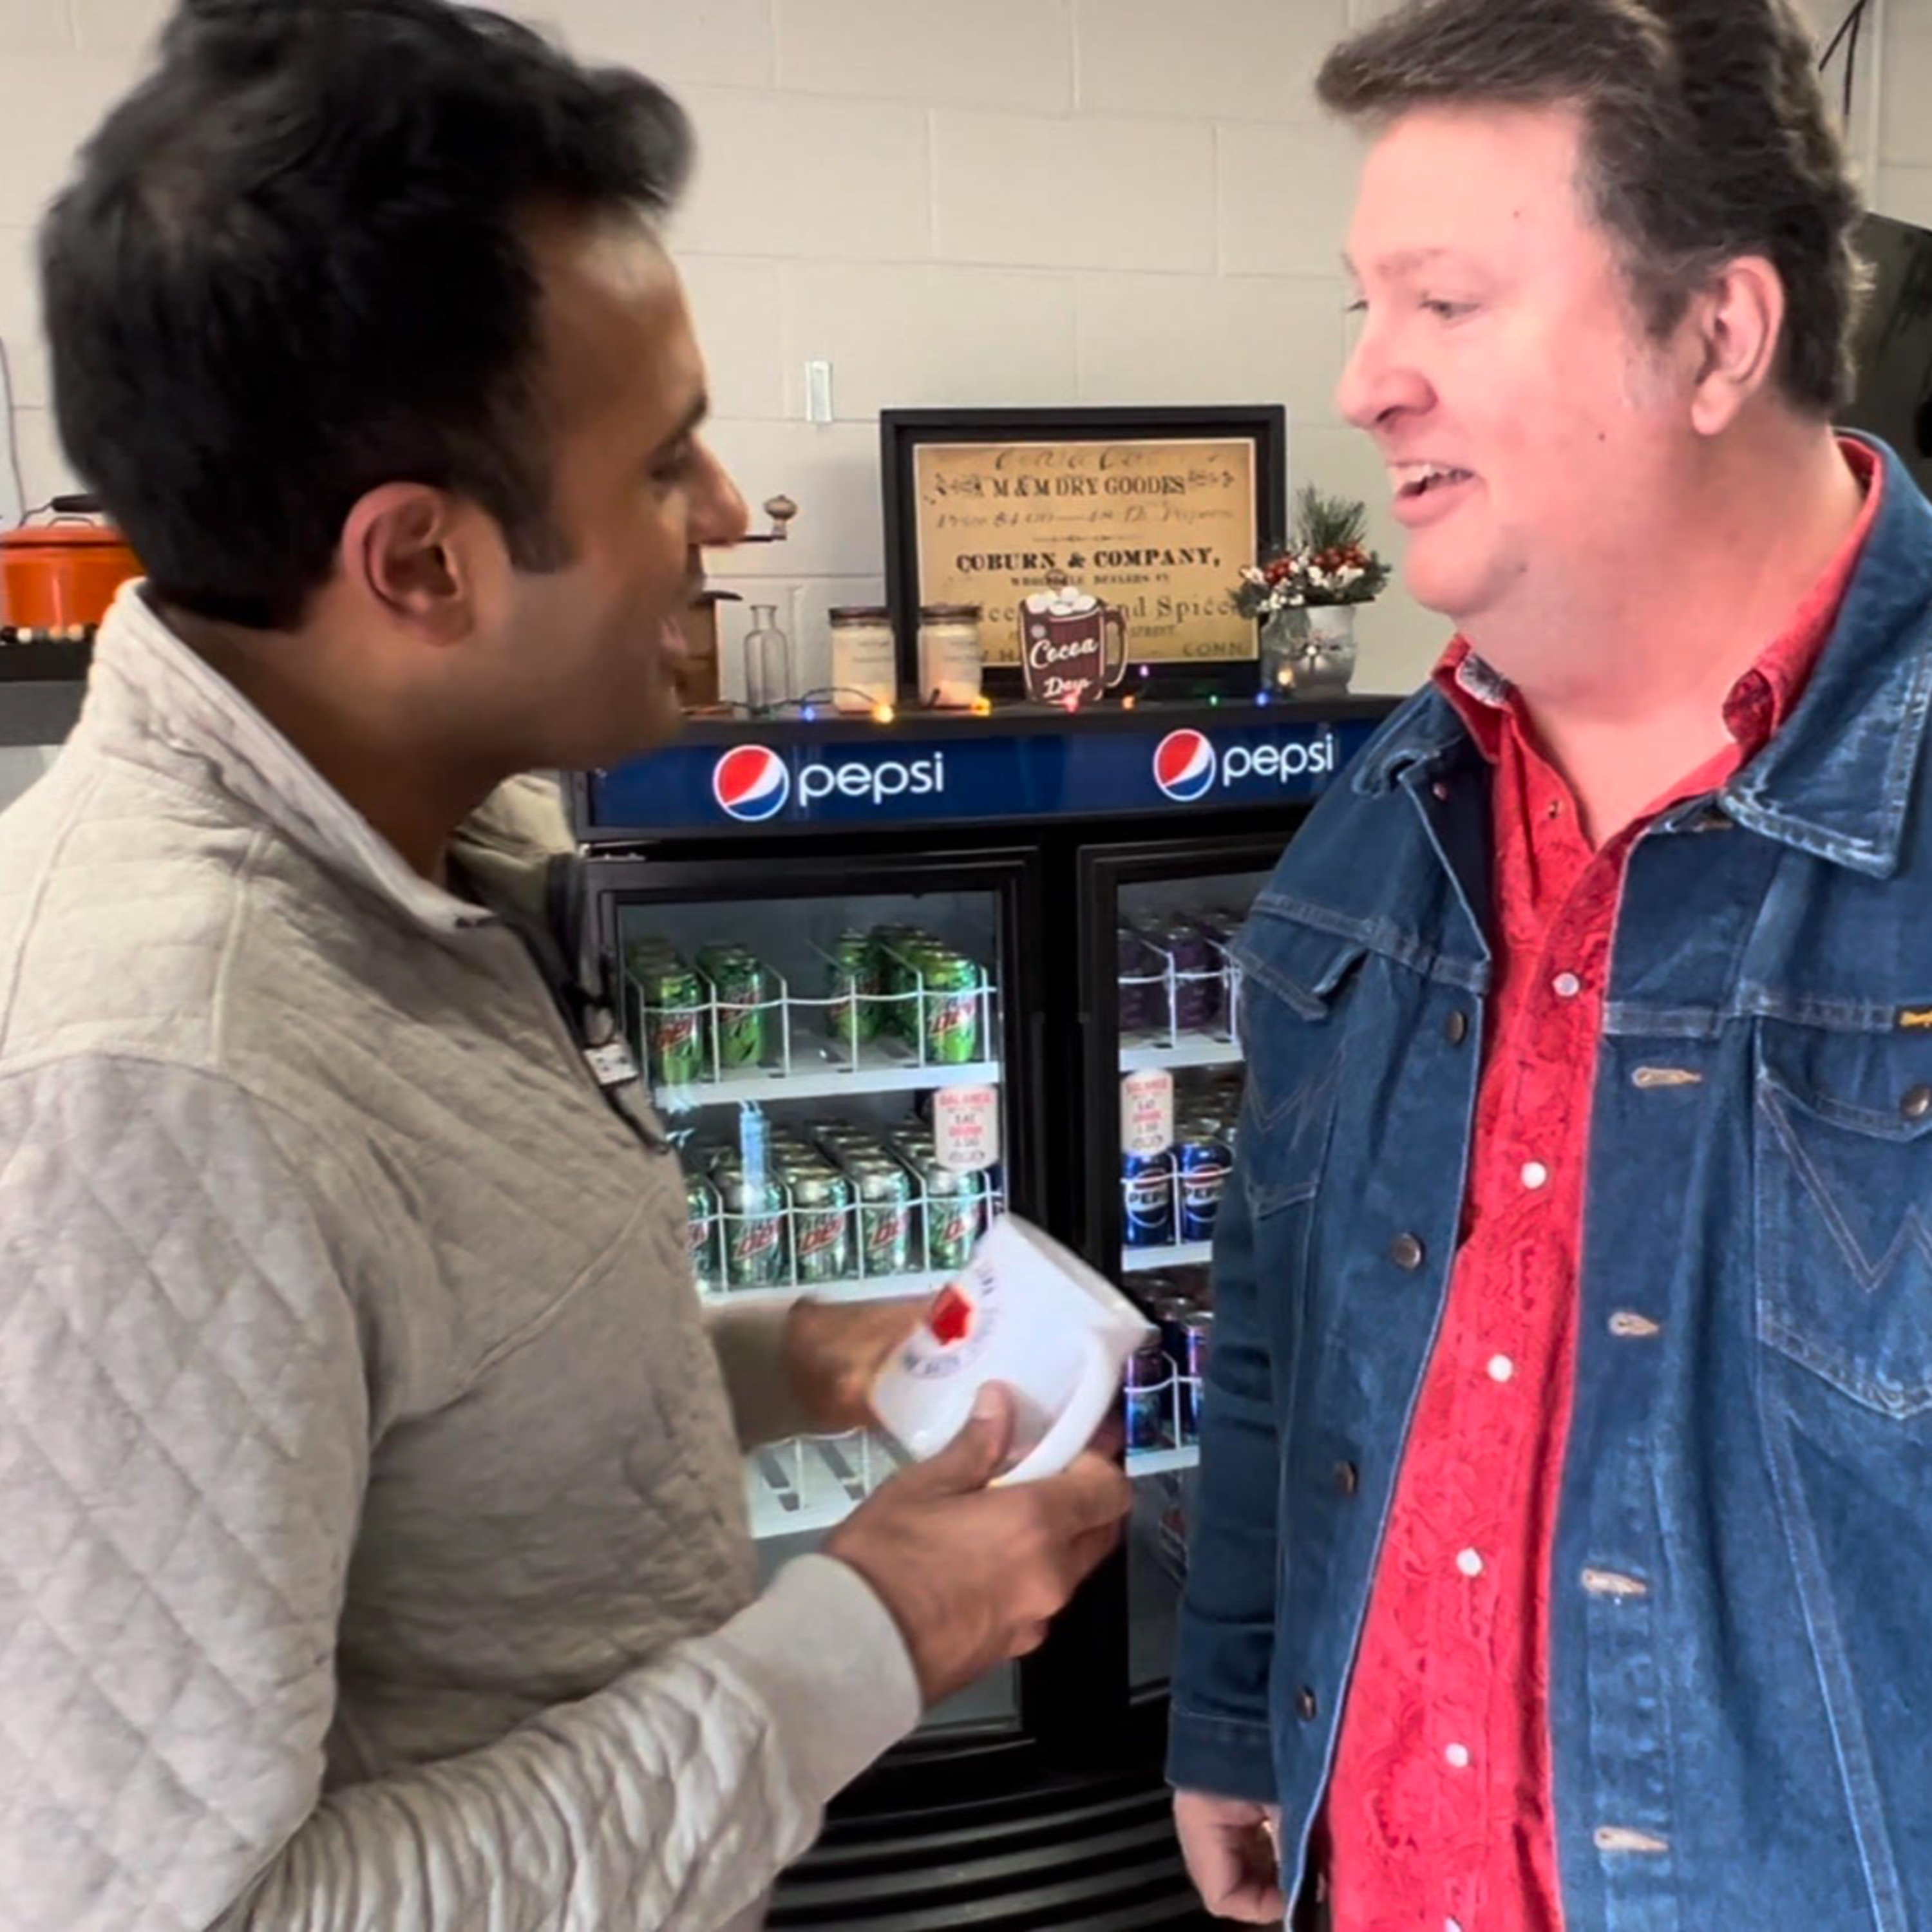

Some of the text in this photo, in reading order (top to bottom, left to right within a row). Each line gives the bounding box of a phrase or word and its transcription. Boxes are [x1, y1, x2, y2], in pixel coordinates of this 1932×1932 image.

[1056, 476, 1098, 496] DRY
[956, 547, 1220, 573] COBURN & COMPANY,
[1030, 638, 1099, 670] Cocoa
[1222, 732, 1334, 786] pepsi
[799, 752, 944, 807] pepsi
